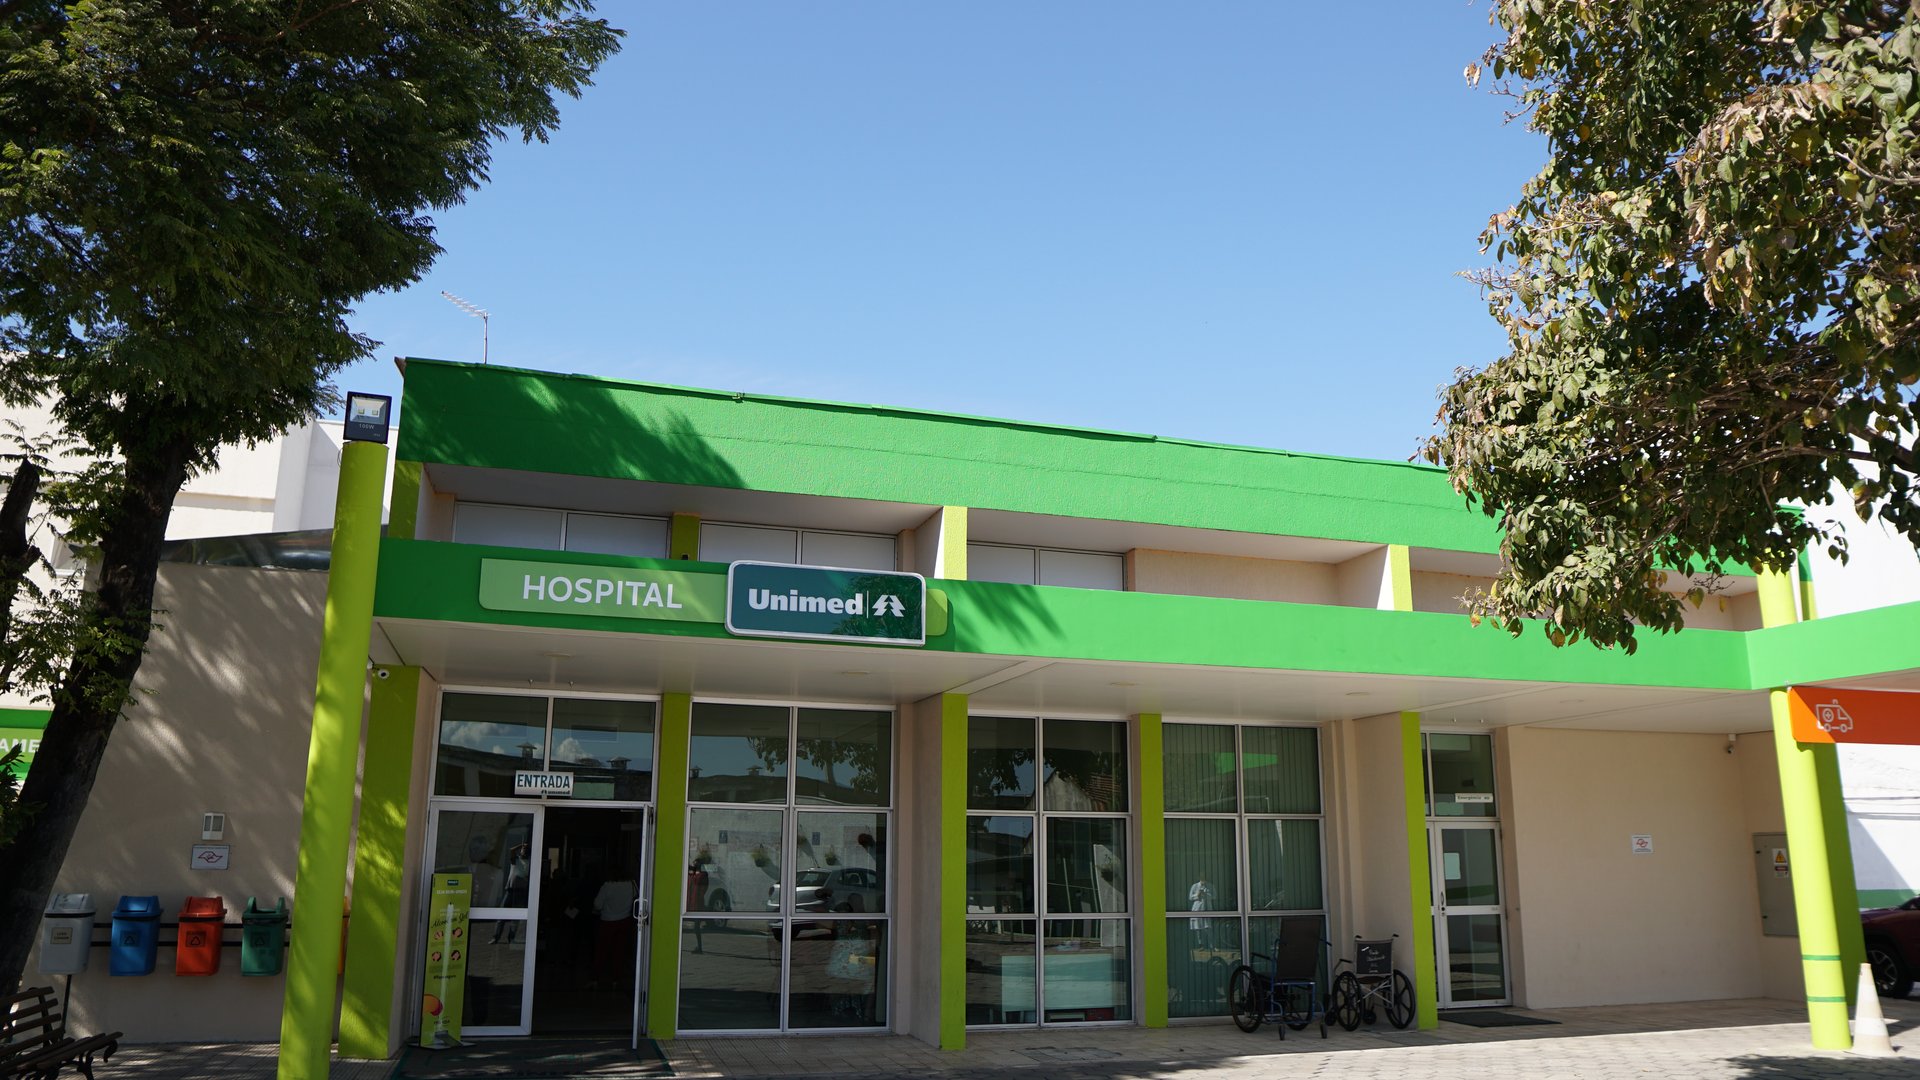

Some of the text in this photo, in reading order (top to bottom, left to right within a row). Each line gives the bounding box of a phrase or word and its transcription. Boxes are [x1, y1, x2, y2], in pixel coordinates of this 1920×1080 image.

[522, 575, 683, 609] HOSPITAL
[748, 588, 864, 615] Unimed
[517, 774, 570, 788] ENTRADA
